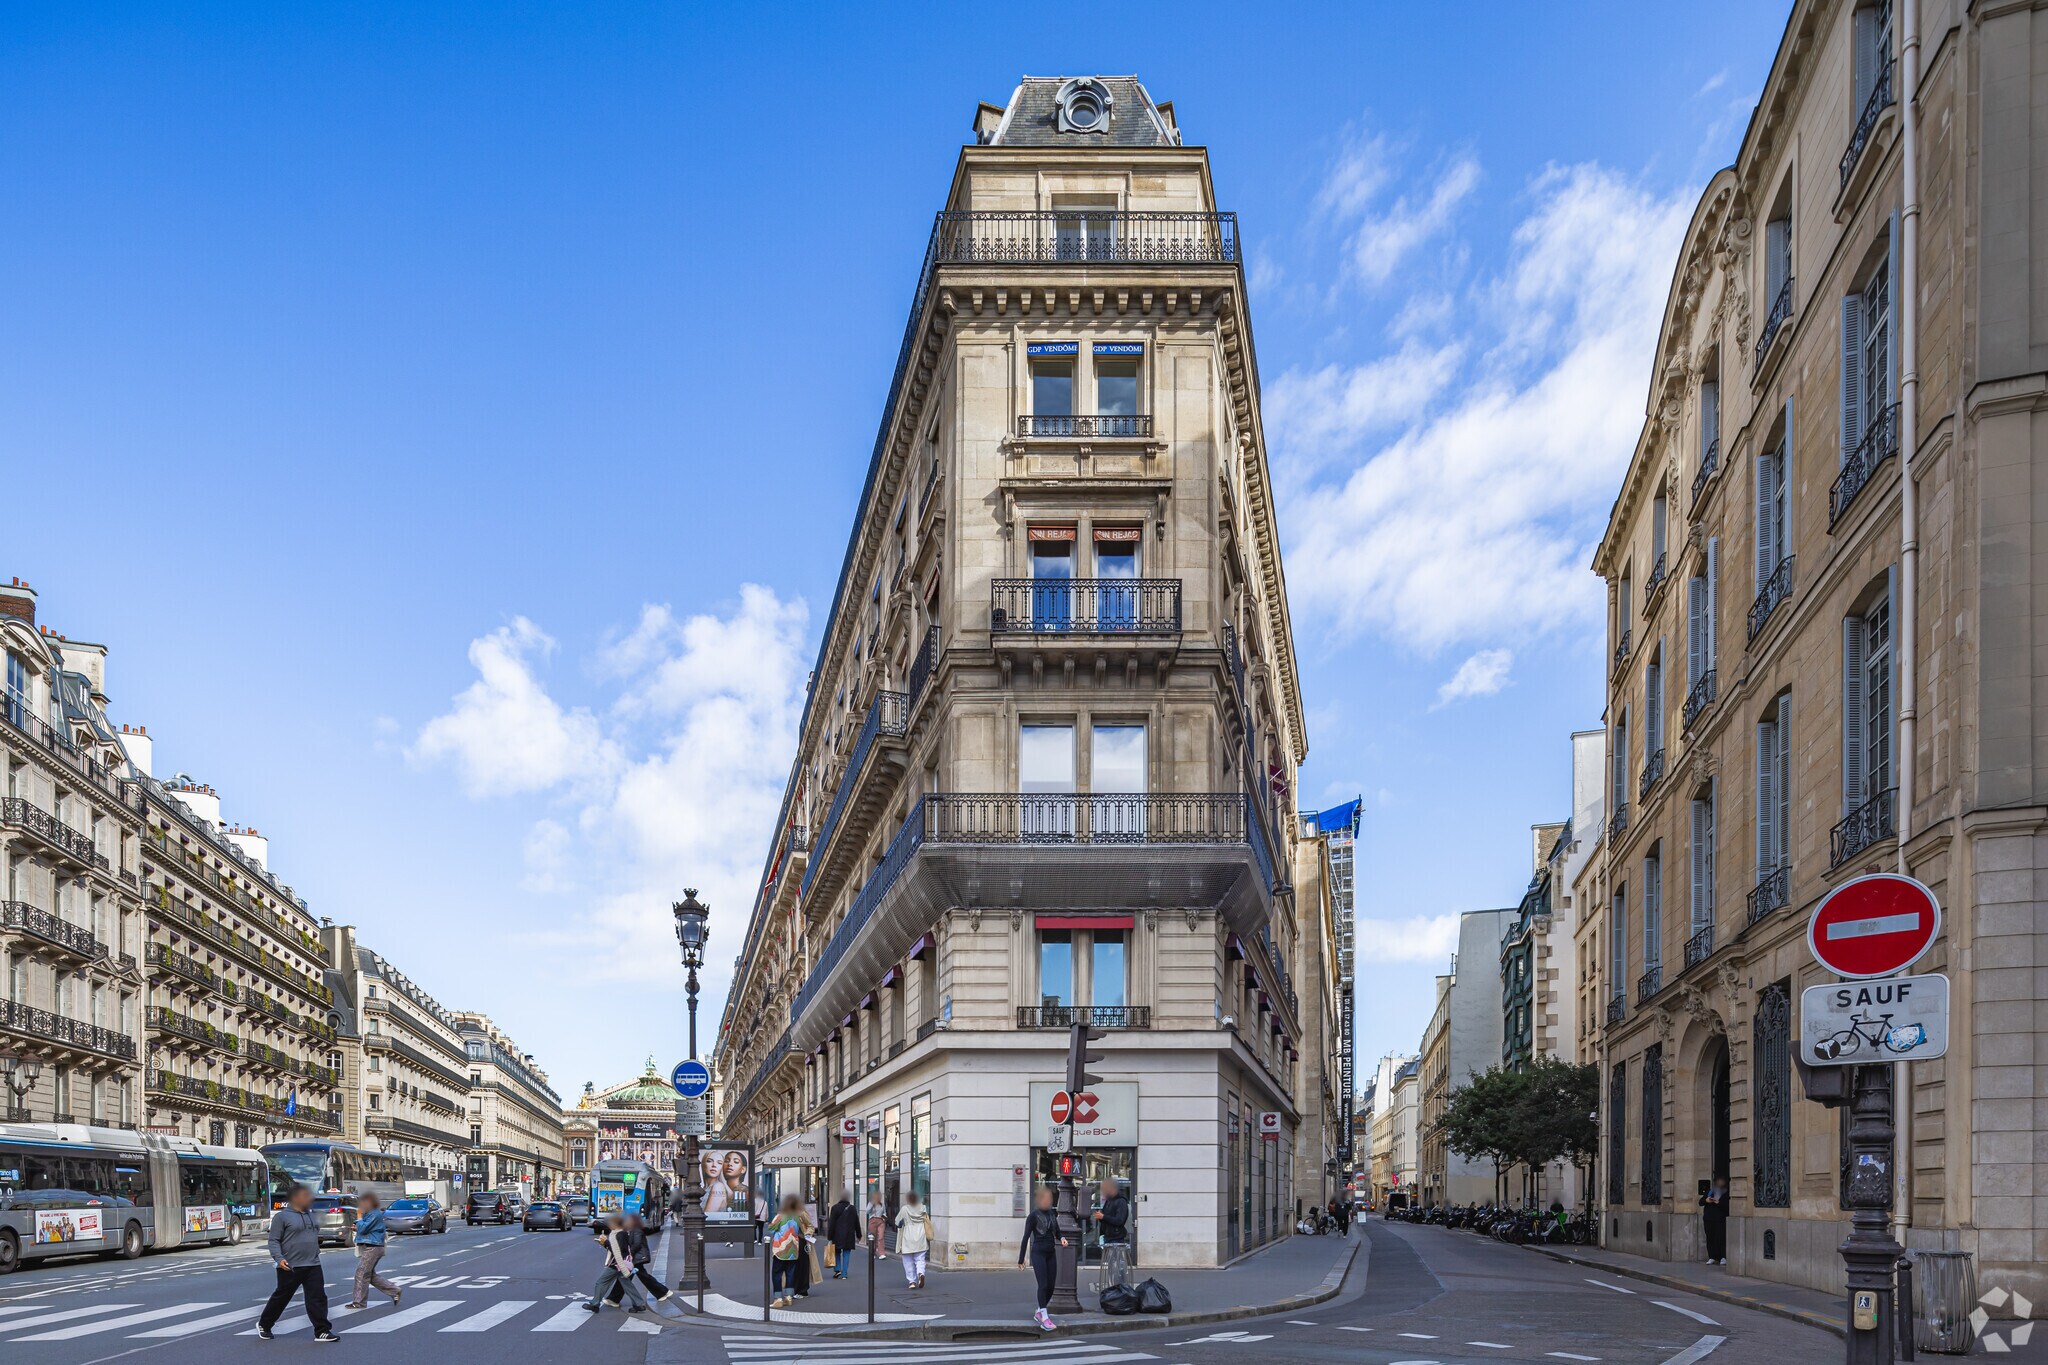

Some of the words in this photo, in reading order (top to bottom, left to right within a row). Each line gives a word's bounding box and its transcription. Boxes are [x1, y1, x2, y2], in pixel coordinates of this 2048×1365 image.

[1836, 983, 1912, 1008] SAUF
[1343, 1039, 1351, 1054] MB
[1343, 1056, 1351, 1099] PEINTURE
